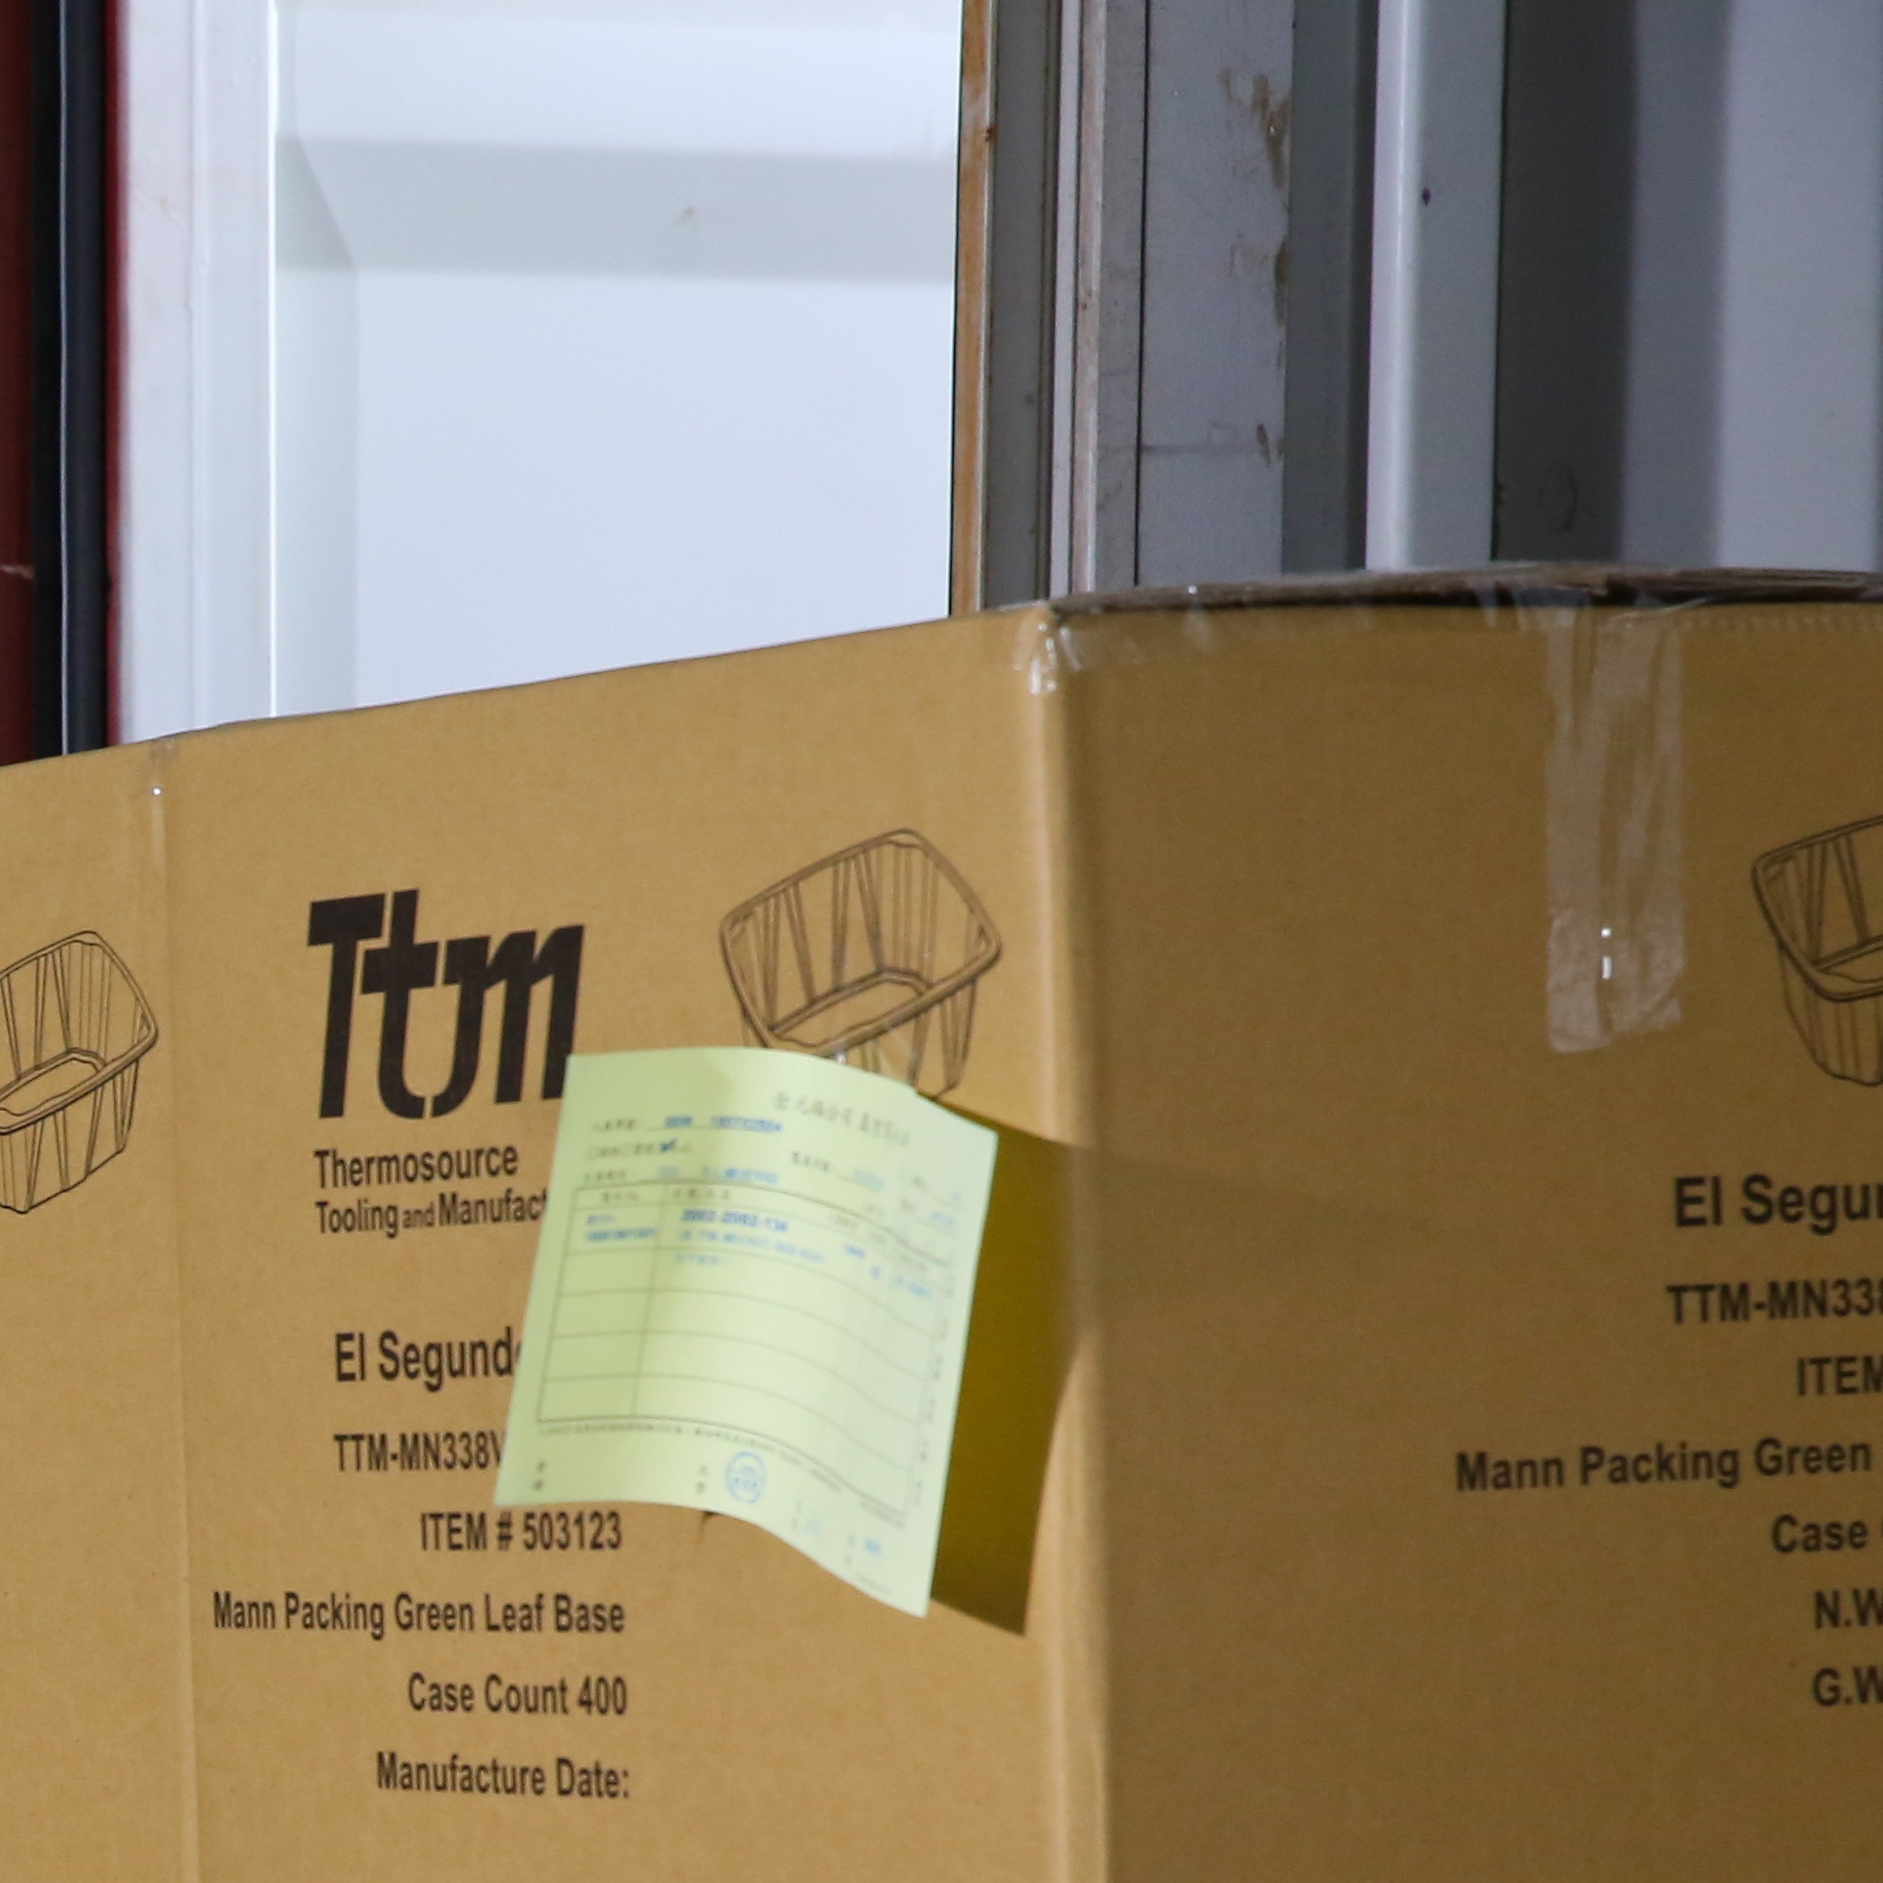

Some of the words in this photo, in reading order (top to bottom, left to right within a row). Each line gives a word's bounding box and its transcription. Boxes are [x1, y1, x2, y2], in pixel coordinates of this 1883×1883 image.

[313, 1145, 519, 1189] Thermosource
[314, 1199, 399, 1240] Tooling
[402, 1202, 435, 1229] and
[1674, 1175, 1723, 1228] El
[335, 1332, 366, 1382] El
[378, 1326, 520, 1393] Segund
[1456, 1451, 1565, 1491] Mann
[1579, 1441, 1740, 1490] Packing
[1753, 1436, 1872, 1477] Green
[420, 1511, 488, 1551] ITEM
[496, 1512, 513, 1550] #
[523, 1510, 622, 1551] 503123
[1771, 1513, 1869, 1555] Case
[213, 1591, 276, 1629] Mann
[284, 1591, 385, 1642] Packing
[394, 1591, 475, 1632] Green
[484, 1592, 544, 1633] Leaf
[553, 1593, 625, 1634] Base
[408, 1671, 474, 1713] Case
[484, 1673, 569, 1715] Count
[577, 1676, 627, 1716] 400
[376, 1750, 546, 1797] Manufacture
[555, 1756, 629, 1799] Date:
